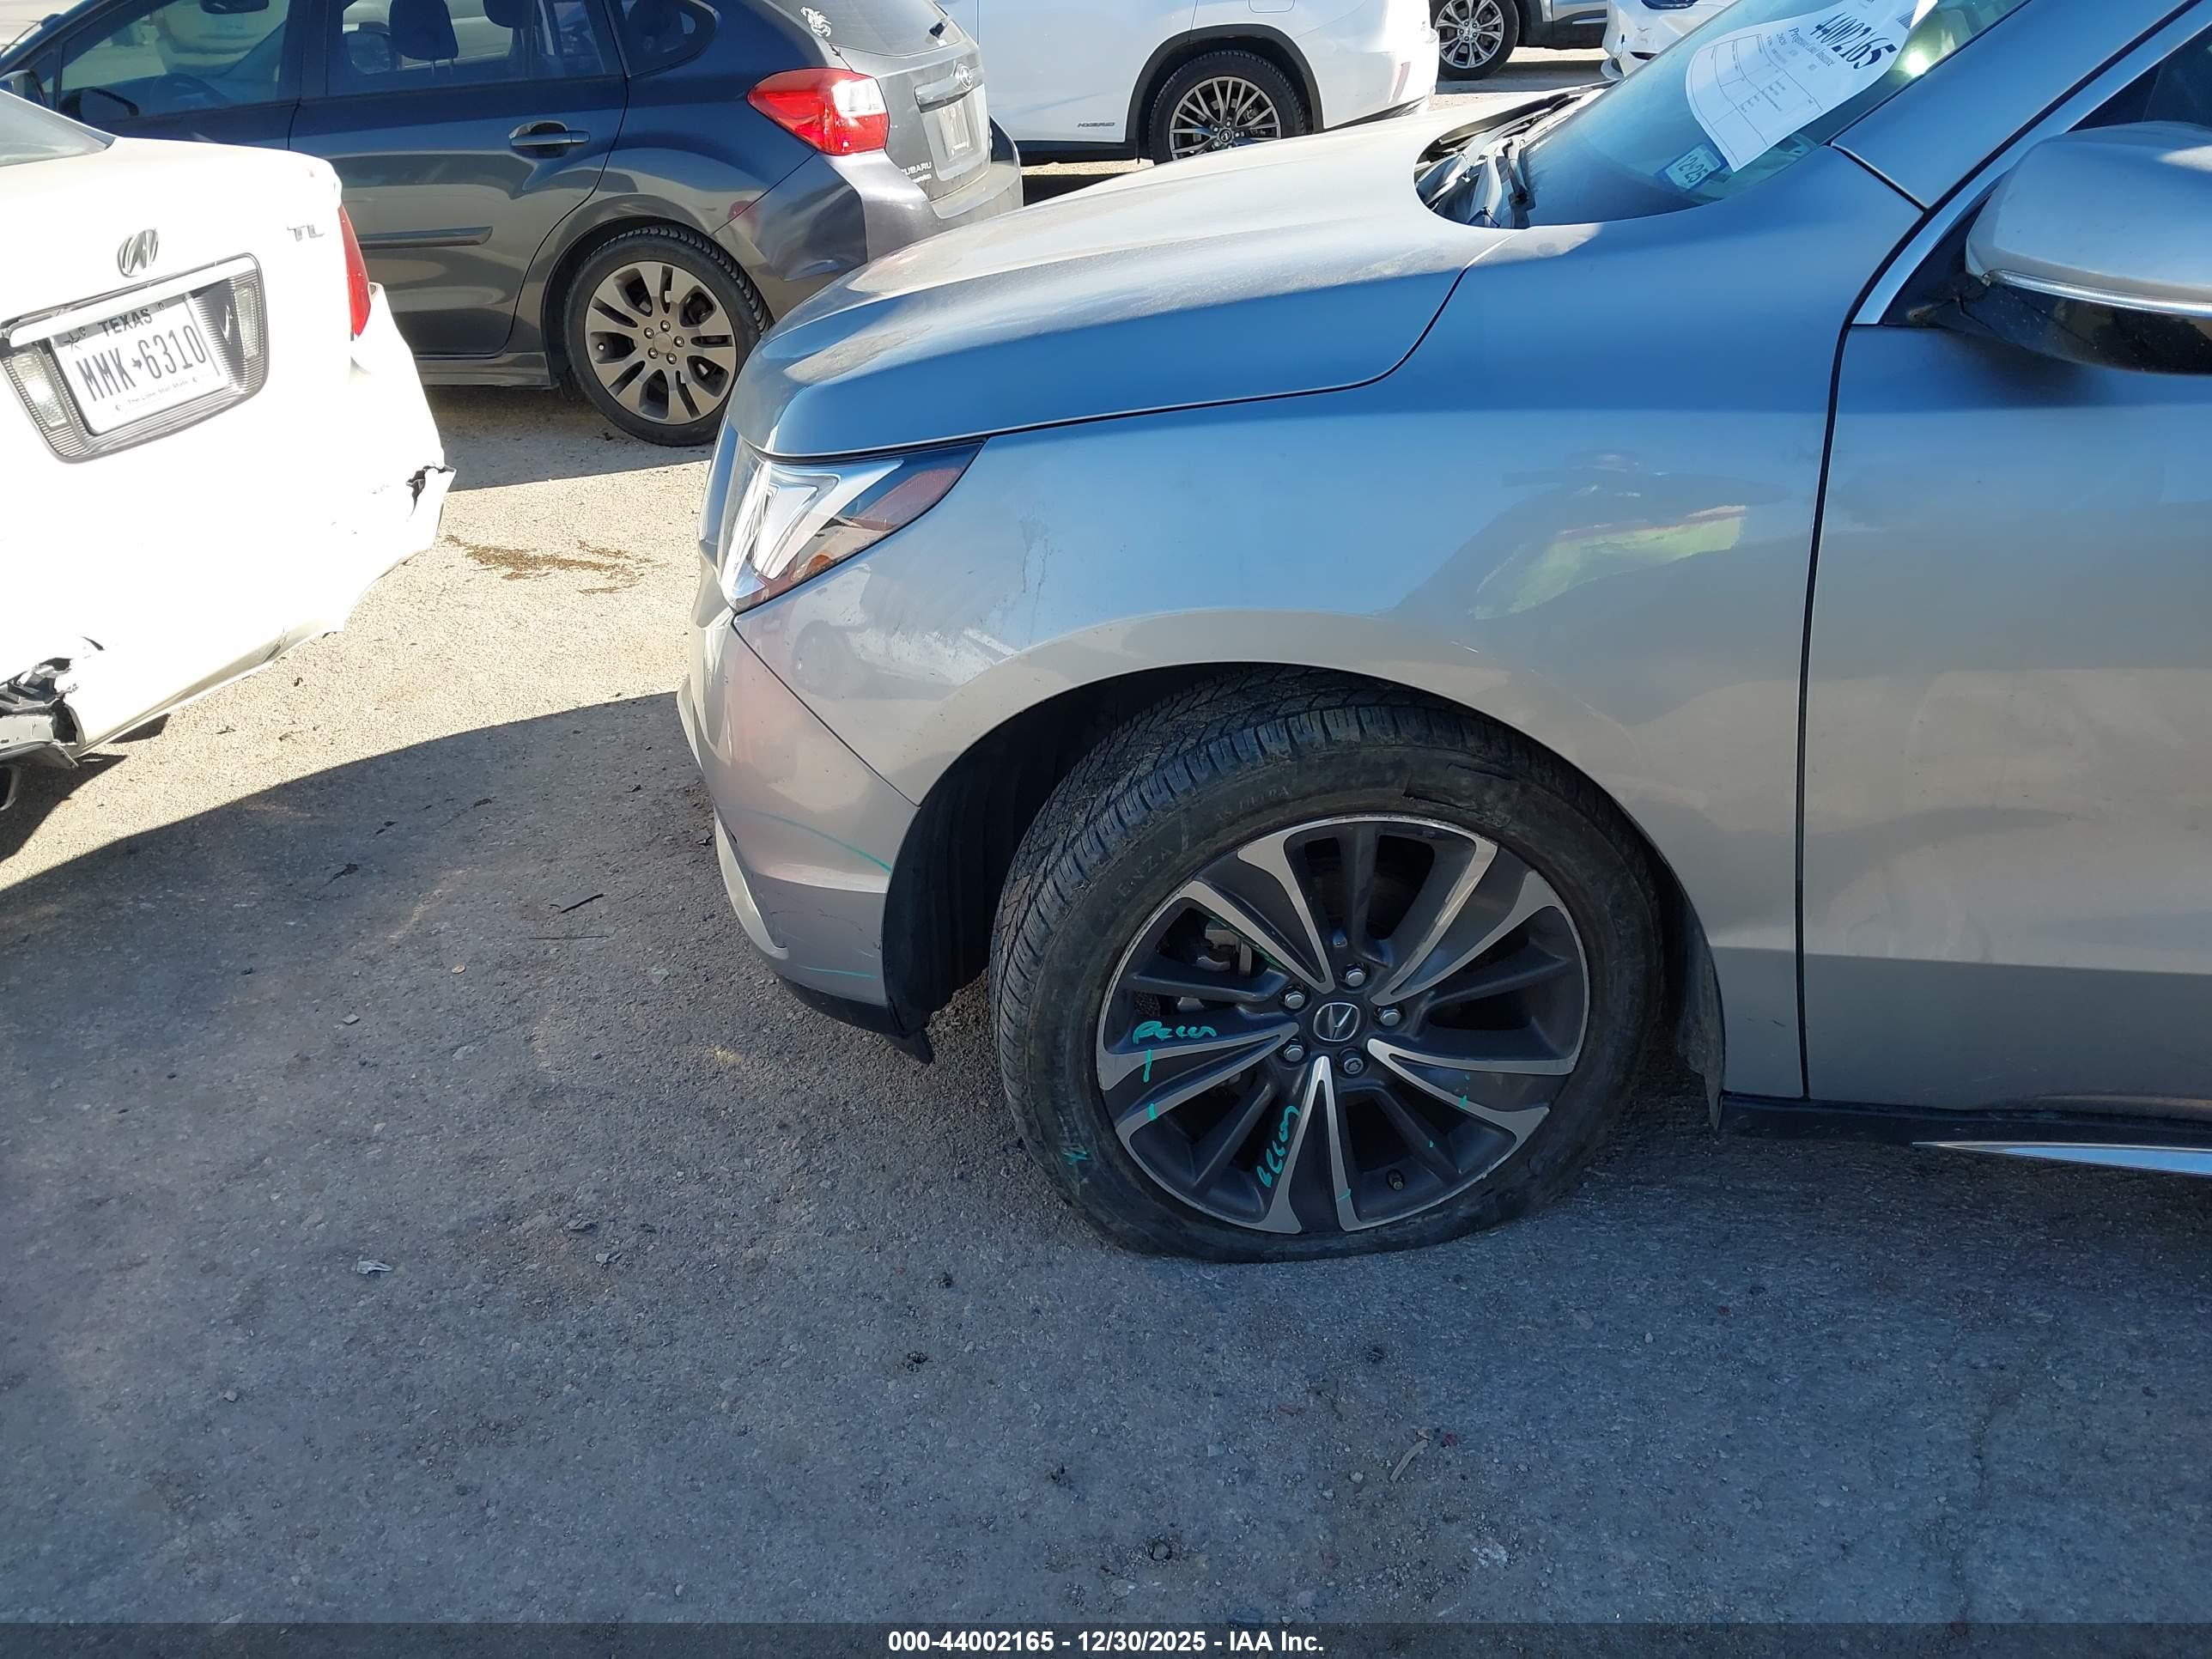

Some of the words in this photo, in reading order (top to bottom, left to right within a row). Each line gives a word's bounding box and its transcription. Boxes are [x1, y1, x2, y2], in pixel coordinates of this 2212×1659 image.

[1809, 11, 1897, 70] 44002165
[287, 223, 325, 241] TL
[97, 308, 153, 337] TEXAS
